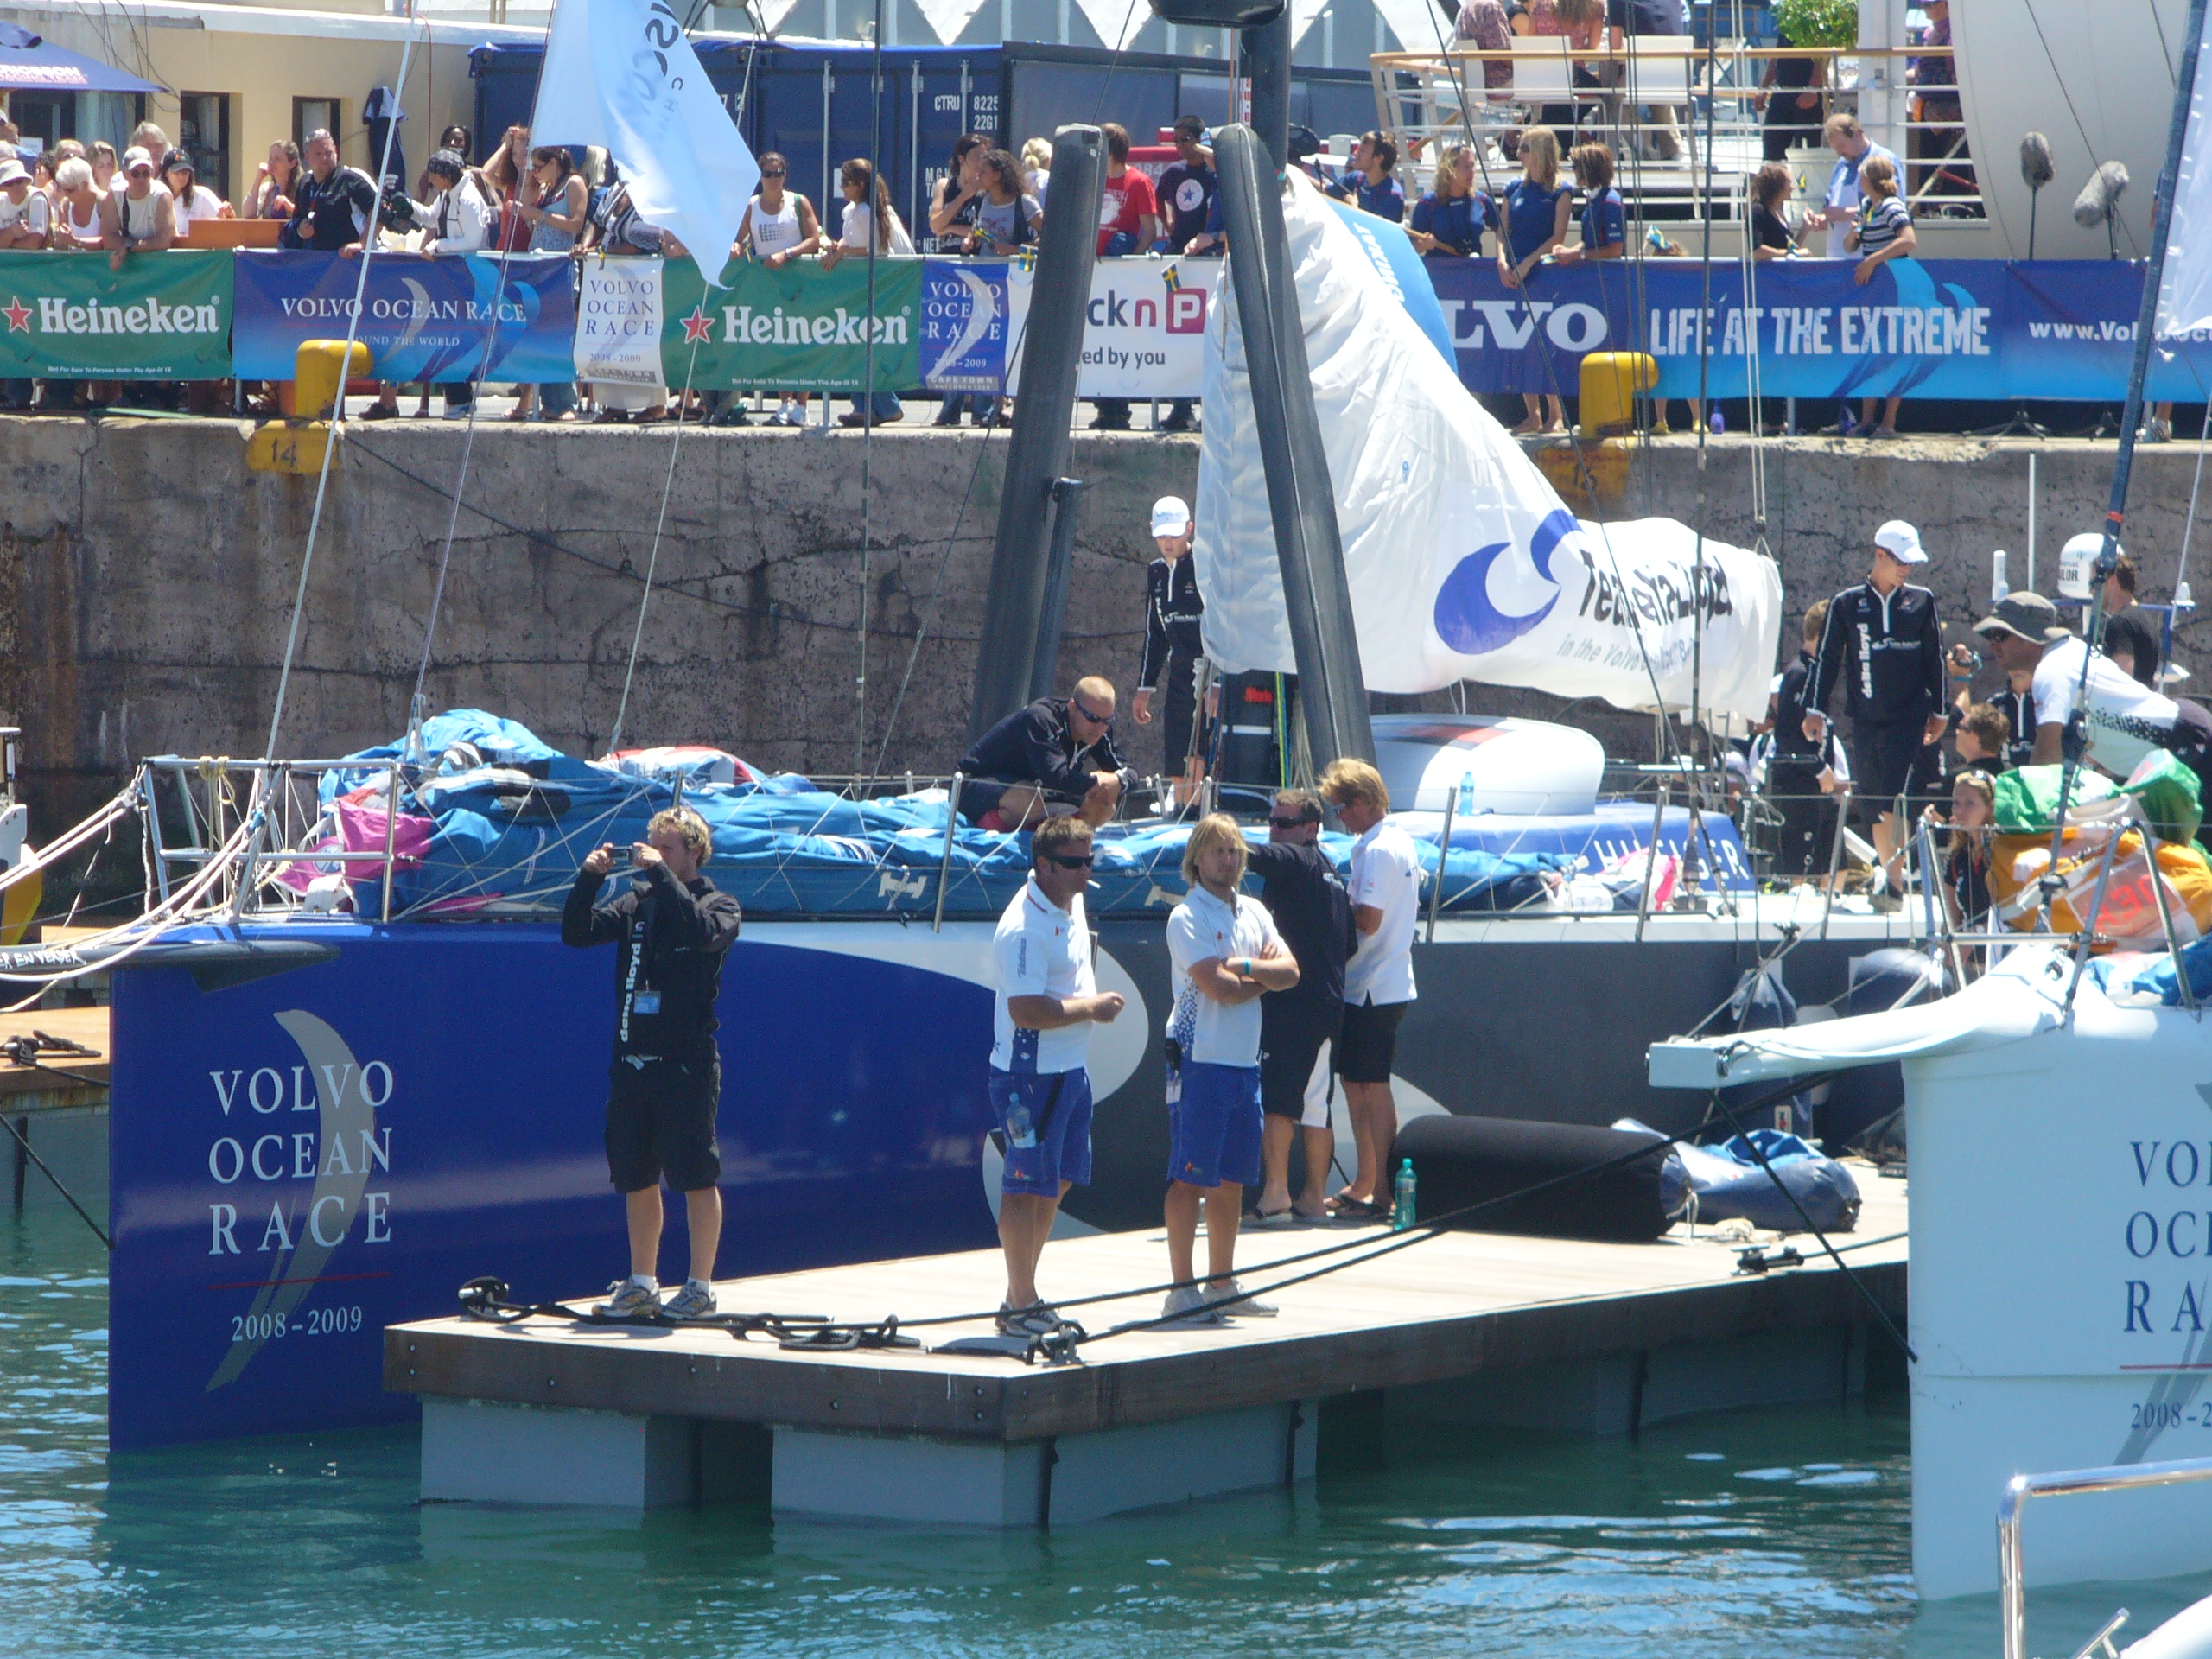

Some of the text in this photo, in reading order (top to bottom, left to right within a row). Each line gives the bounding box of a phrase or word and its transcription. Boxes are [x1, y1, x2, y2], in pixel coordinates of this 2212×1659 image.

[934, 95, 960, 111] CTRU
[974, 115, 999, 130] 22G1
[590, 279, 654, 295] VOLVO
[930, 281, 1001, 298] VOLVO
[37, 297, 219, 334] Heineken
[281, 297, 527, 321] VOLVO OCEAN RACE
[588, 300, 654, 315] OCEAN
[928, 302, 1001, 318] OCEAN
[1086, 289, 1128, 327] ck
[355, 336, 461, 346] OUND THE WORLD
[586, 319, 655, 336] RACE
[721, 306, 908, 345] Heineken
[927, 321, 1001, 340] RACE
[1437, 299, 1609, 352] LVO
[1650, 307, 1991, 355] LIFE AT THE EXTREME
[1082, 346, 1166, 370] ed by you
[271, 438, 296, 467] 14
[1573, 638, 1602, 662] the
[1603, 643, 1640, 671] Volvo
[626, 943, 641, 990] lloyd
[209, 1060, 393, 1116] VOLVO
[209, 1128, 392, 1184] OCEAN
[2130, 1141, 2212, 1188] VO
[209, 1192, 391, 1255] RACE
[232, 1306, 362, 1341] 2008-2009
